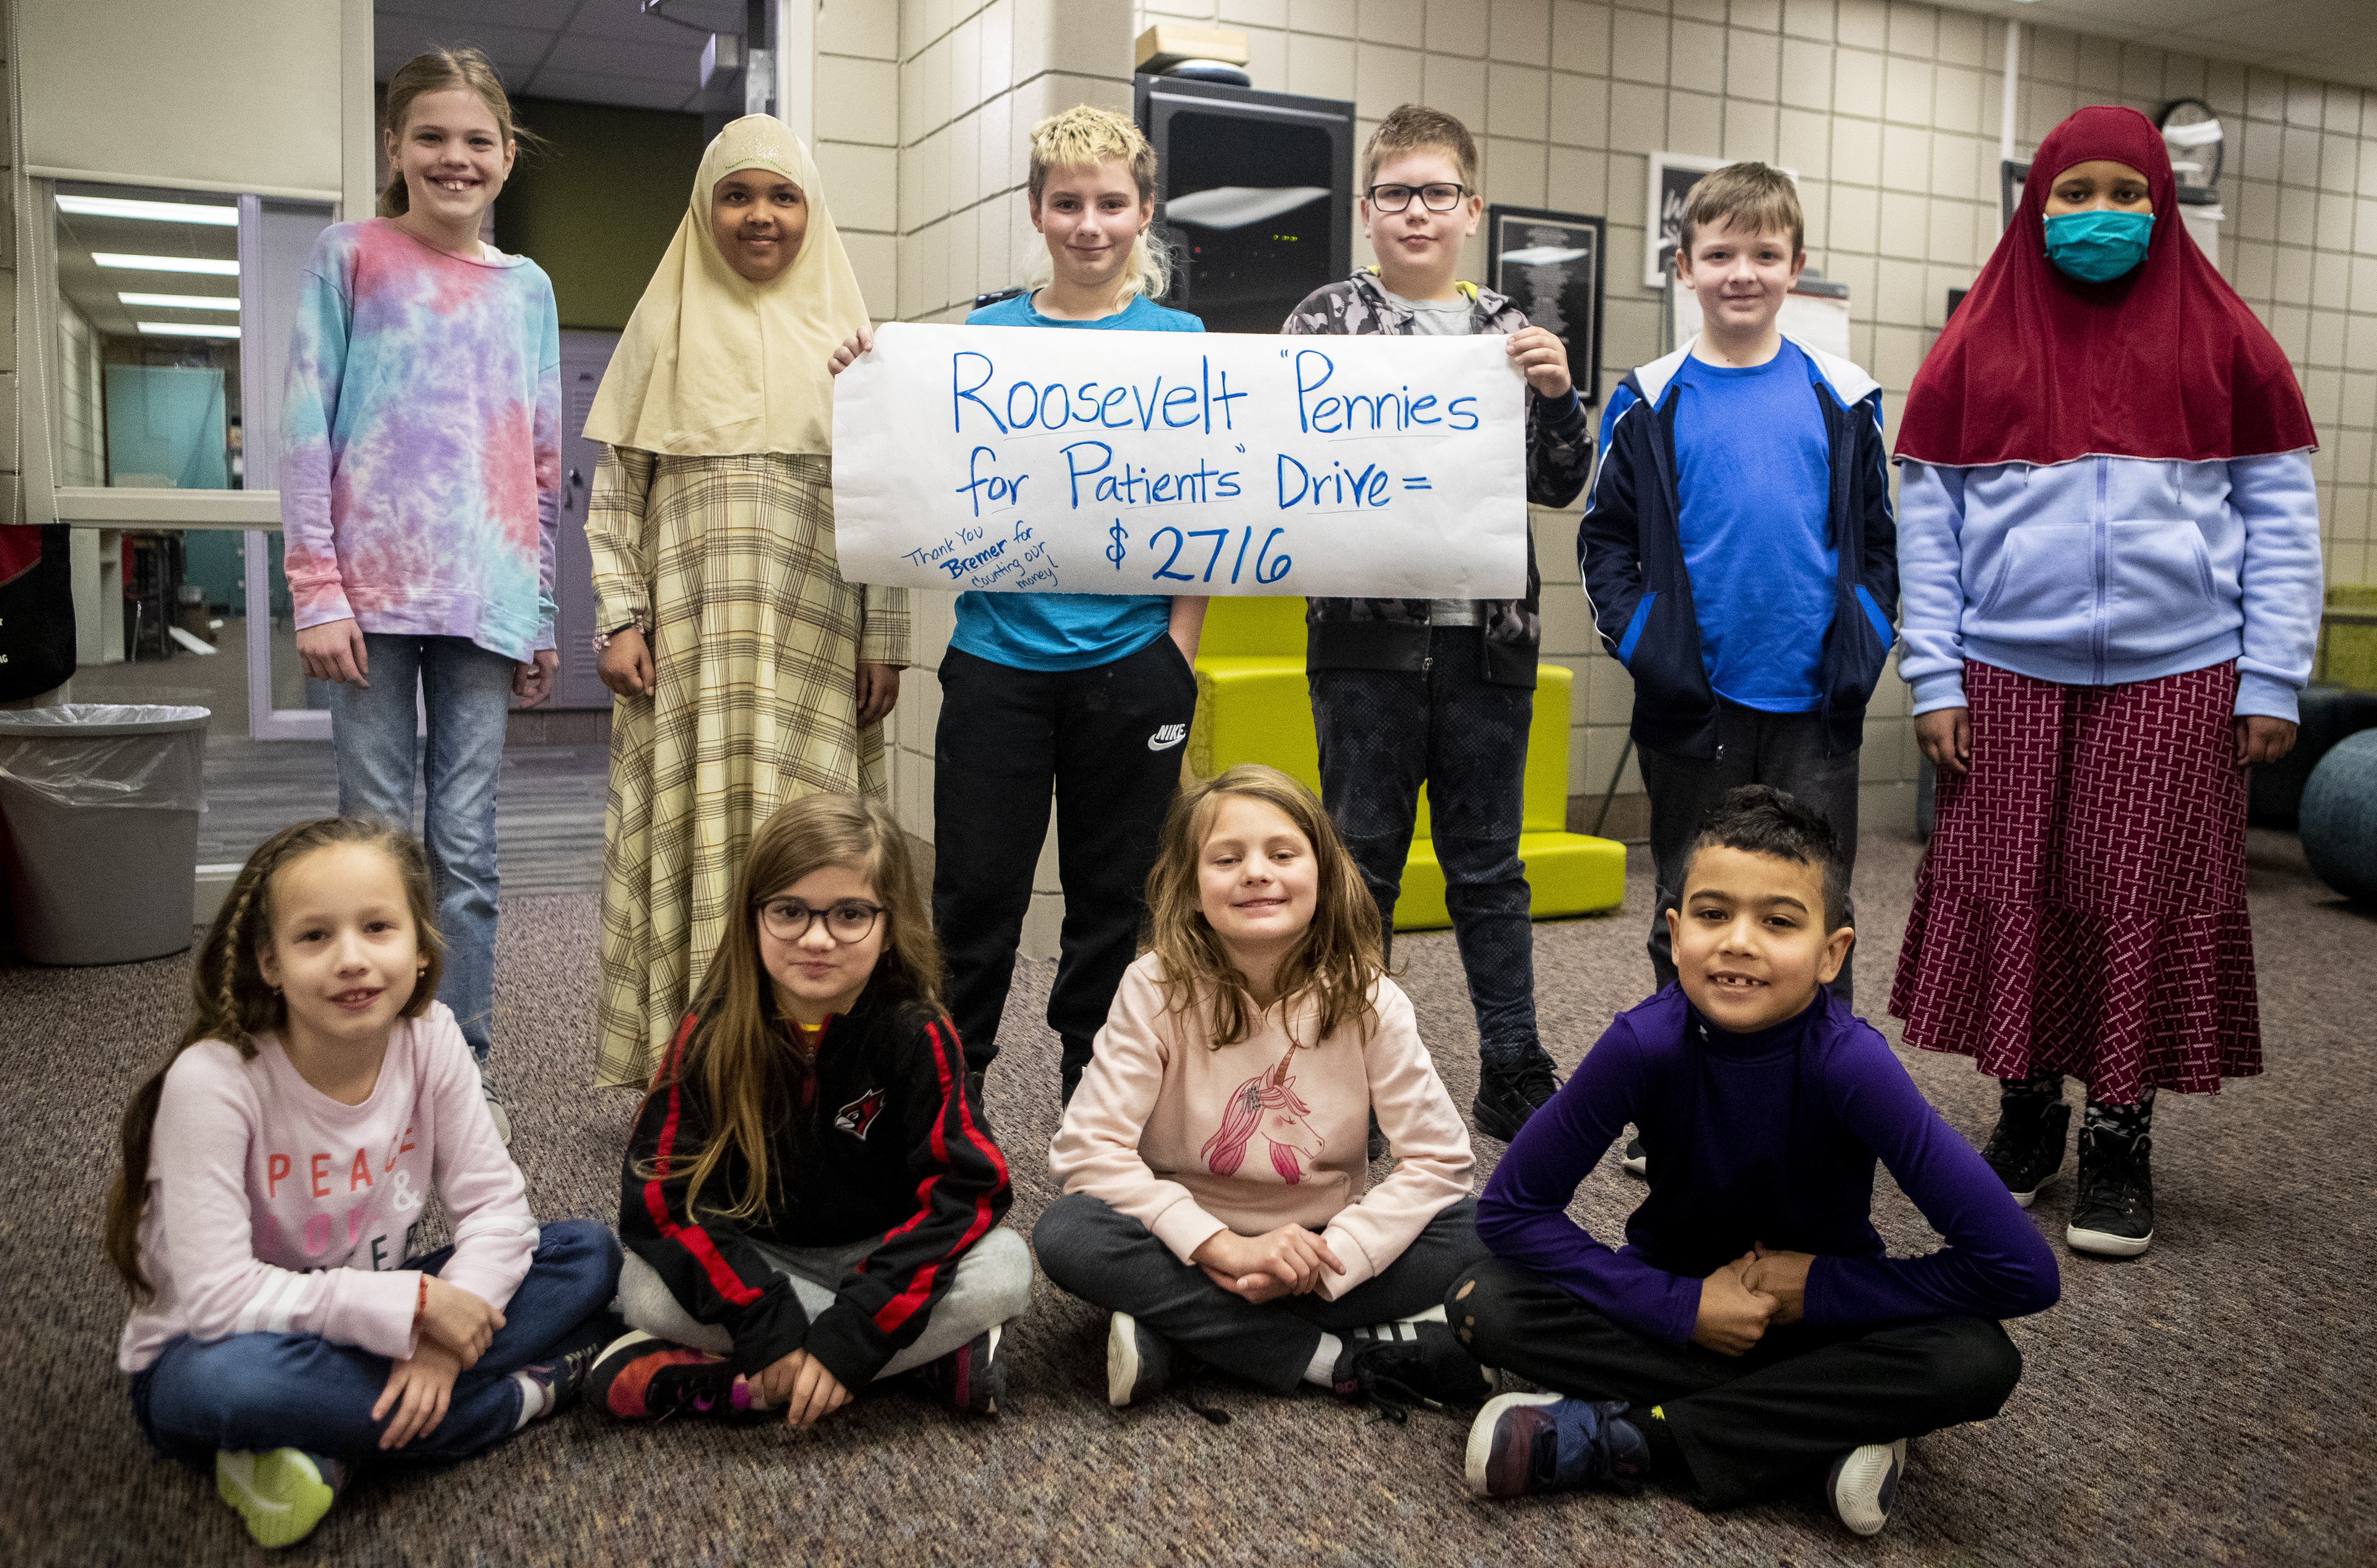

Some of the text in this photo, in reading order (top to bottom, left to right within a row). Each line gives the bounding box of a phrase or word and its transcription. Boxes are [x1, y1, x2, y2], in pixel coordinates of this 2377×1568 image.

[953, 351, 1248, 435] Roosevelt
[956, 446, 1029, 517] for
[901, 526, 983, 567] Thank You
[939, 520, 1033, 580] Bremer for
[1024, 541, 1045, 562] our
[1155, 723, 1186, 741] NIKE
